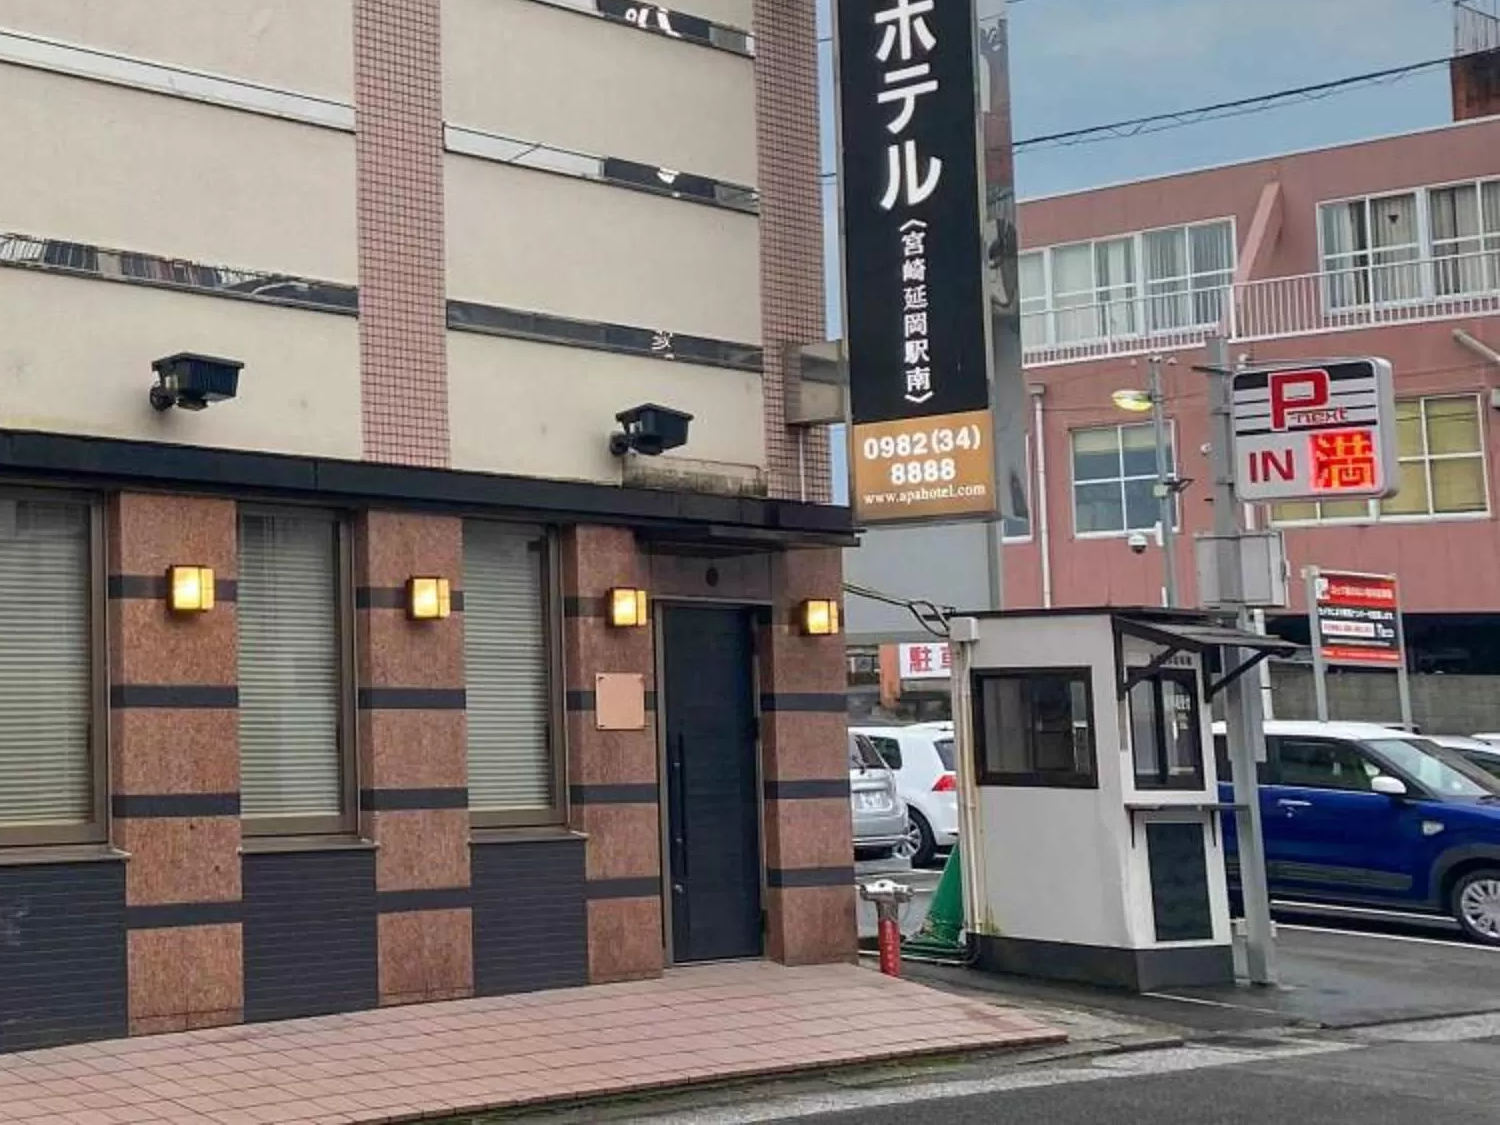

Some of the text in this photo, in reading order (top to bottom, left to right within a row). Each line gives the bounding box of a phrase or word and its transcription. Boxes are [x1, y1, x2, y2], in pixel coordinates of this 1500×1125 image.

[1271, 370, 1328, 430] P
[863, 423, 982, 460] 0982(34)
[890, 458, 956, 486] 8888
[1249, 449, 1295, 484] IN
[1314, 432, 1375, 492] 満
[863, 483, 986, 506] www.apahotel.com
